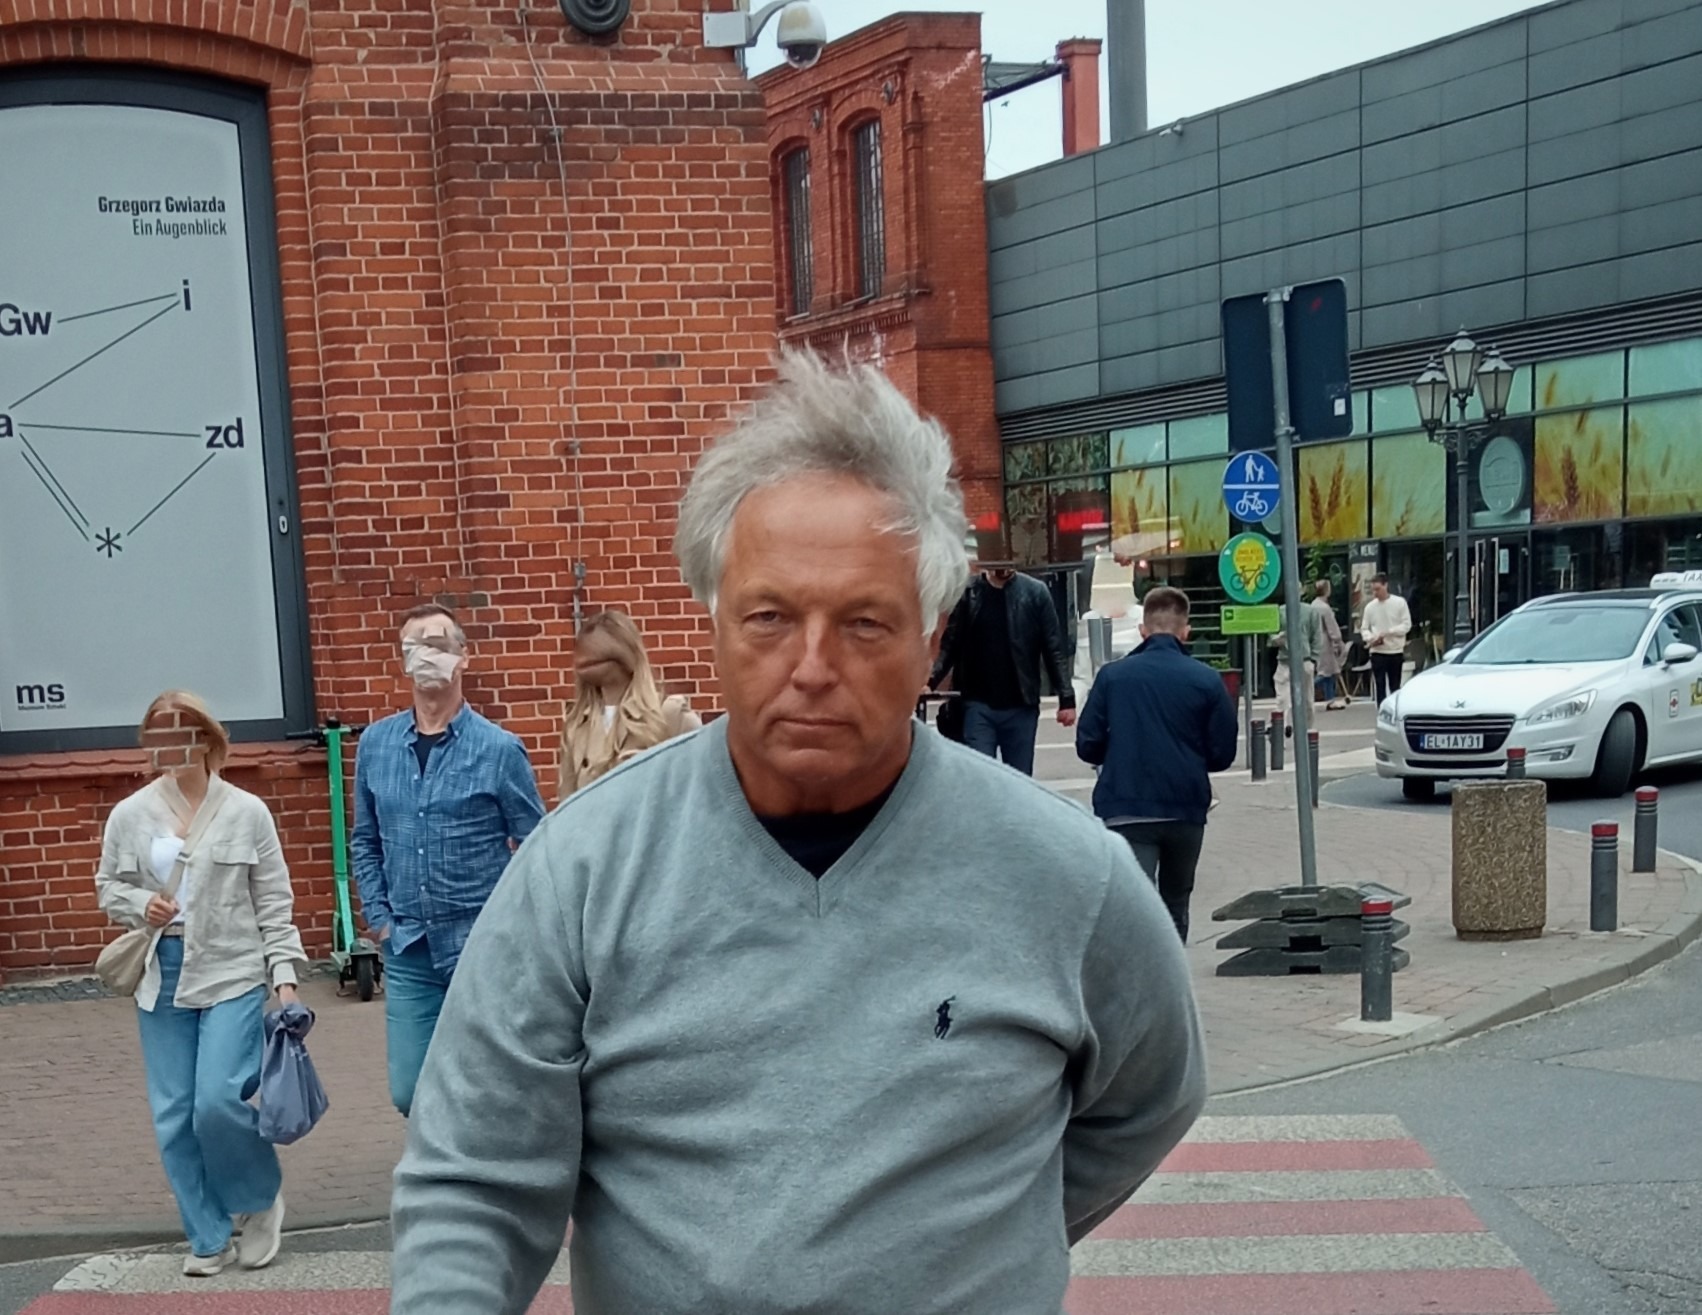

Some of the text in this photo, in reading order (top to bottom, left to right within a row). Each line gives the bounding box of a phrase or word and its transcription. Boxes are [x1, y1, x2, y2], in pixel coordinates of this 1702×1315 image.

[98, 196, 225, 216] Grzegorz Gwiazda
[133, 218, 227, 239] Ein Augenblick
[0, 303, 51, 336] Gw
[205, 417, 244, 448] zd
[16, 684, 65, 704] ms
